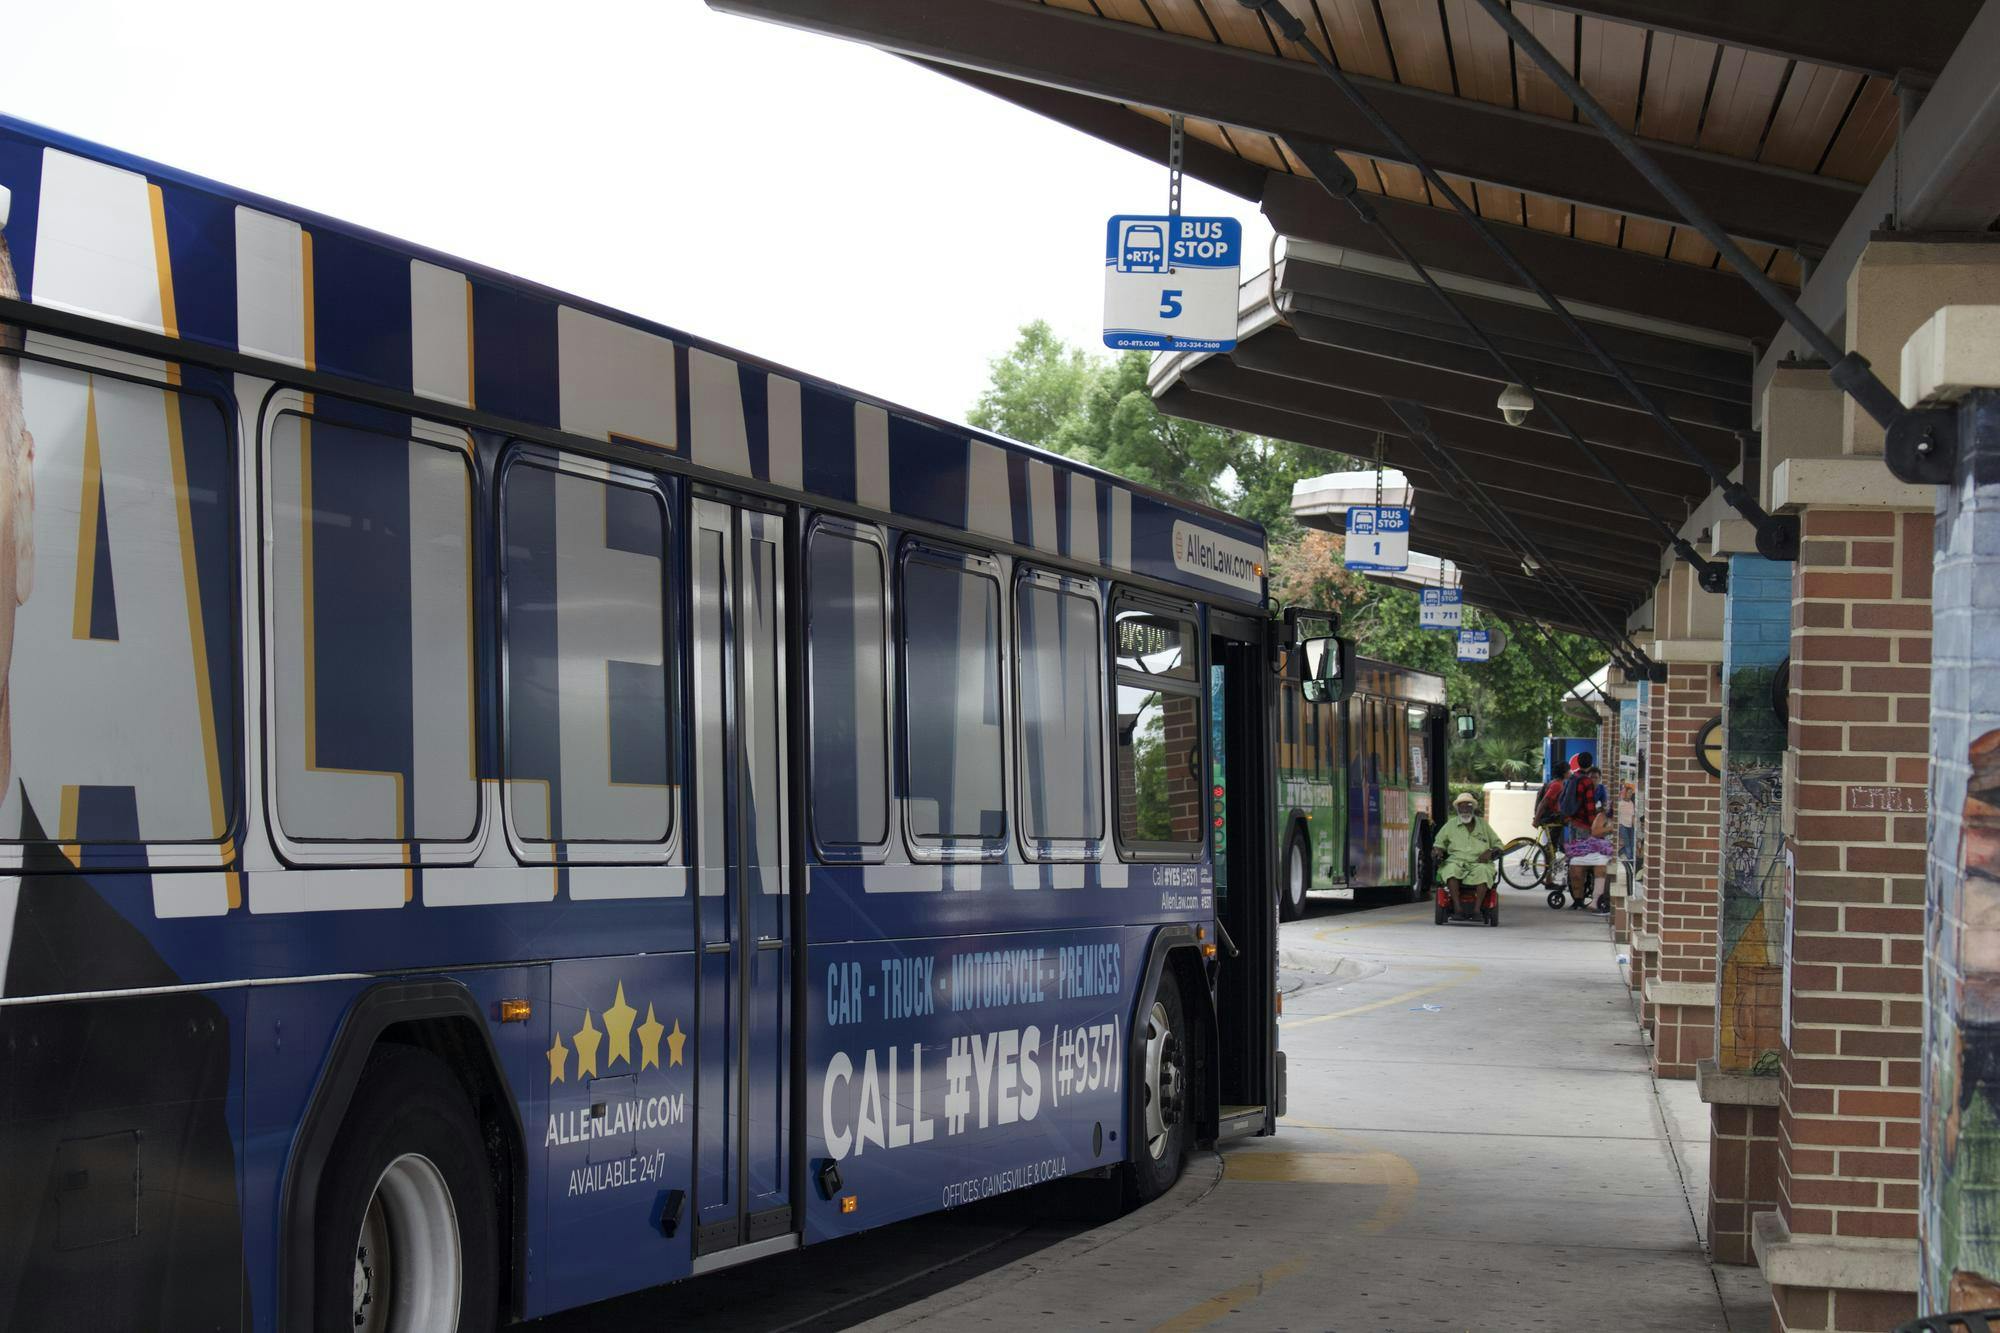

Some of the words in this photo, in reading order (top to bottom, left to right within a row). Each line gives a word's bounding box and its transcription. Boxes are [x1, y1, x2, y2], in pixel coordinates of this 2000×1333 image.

[1174, 241, 1228, 258] STOP
[1181, 222, 1222, 239] BUS
[1160, 290, 1182, 319] 5
[1378, 520, 1404, 528] STOP
[1381, 511, 1401, 519] BUS
[1187, 534, 1254, 582] AllenLaw.com
[1373, 542, 1381, 555] 1
[828, 962, 862, 1026] CAR
[882, 956, 934, 1020] TRUCK
[952, 948, 1044, 1012] MOTORCYCLE
[1059, 943, 1120, 999] PREMISES
[822, 1043, 934, 1161] CALL
[944, 1025, 1041, 1136] #YES
[1051, 1014, 1120, 1108] (#937)
[545, 1093, 684, 1147] ALLENLAW.COM
[568, 1157, 637, 1197] AVAILABLE
[640, 1149, 665, 1183] 24/7
[943, 1182, 981, 1208] OFFICES:
[1041, 1156, 1067, 1181] OCALA
